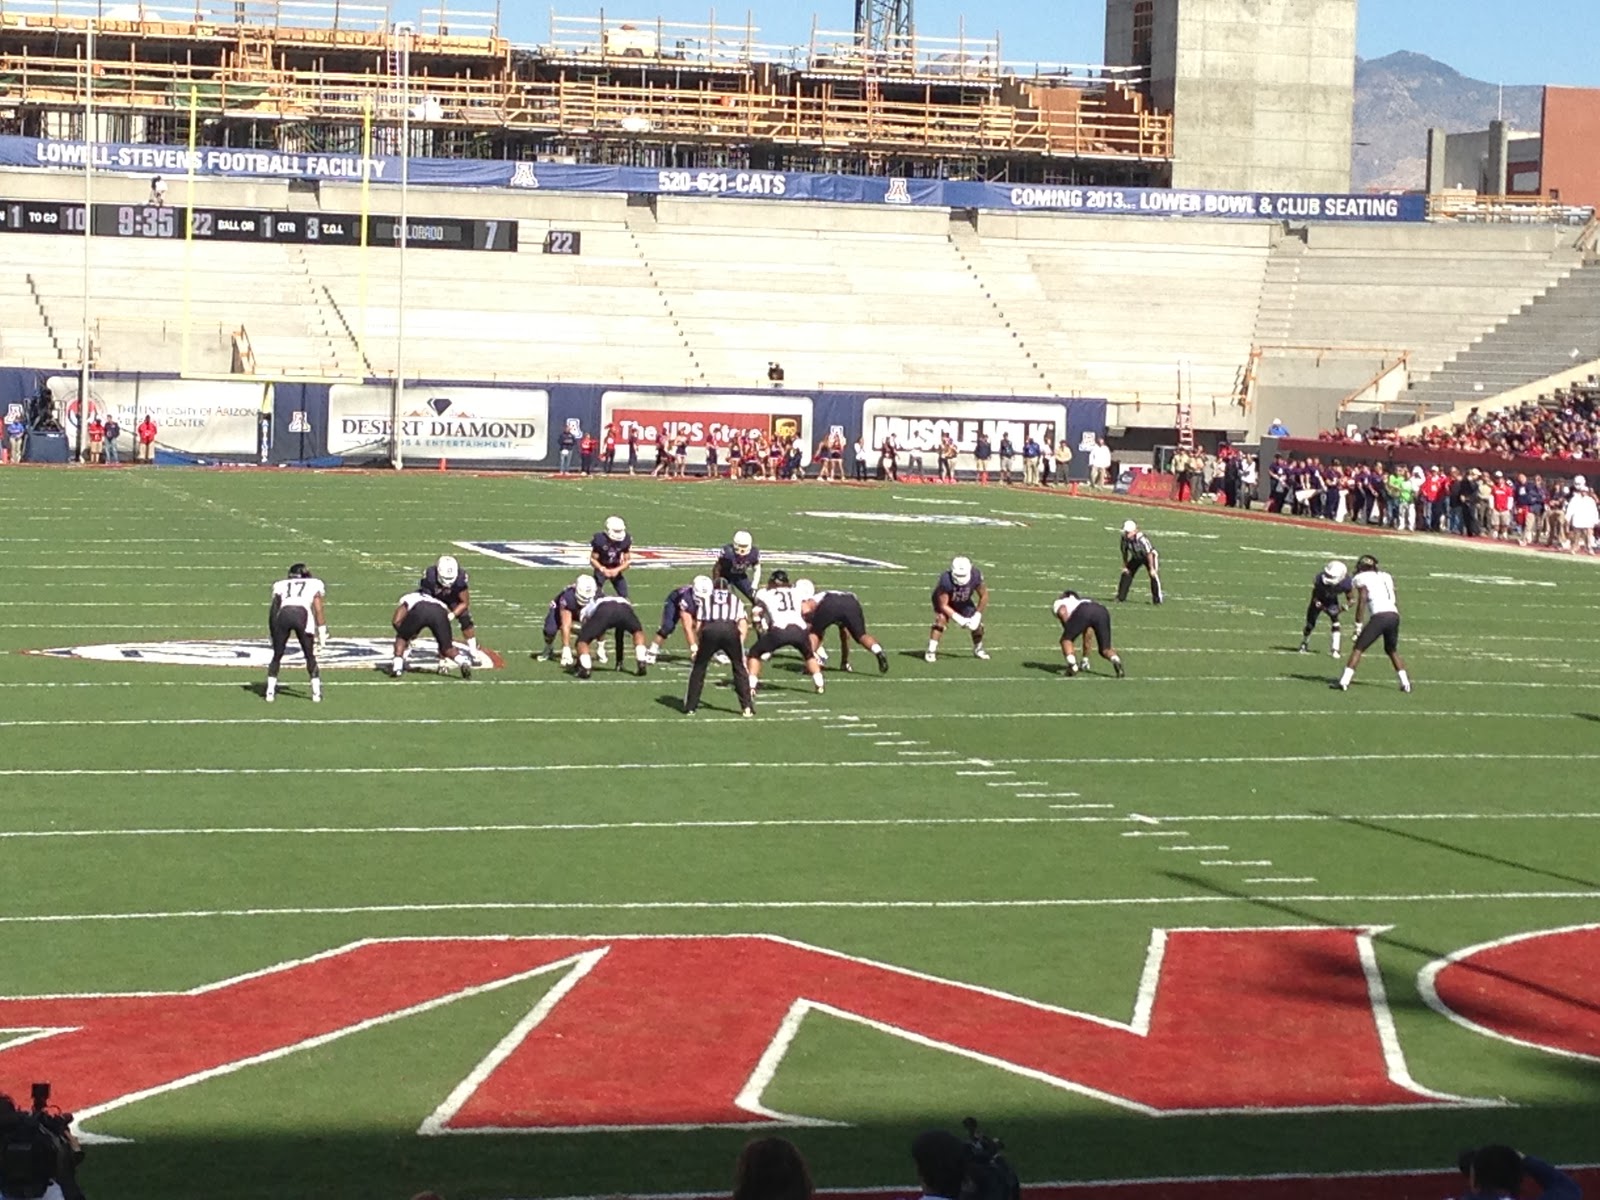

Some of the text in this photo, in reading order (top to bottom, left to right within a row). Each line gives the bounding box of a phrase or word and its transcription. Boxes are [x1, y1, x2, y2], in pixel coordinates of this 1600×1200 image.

[208, 152, 303, 174] FOOTBALL
[658, 172, 786, 195] 520-621-CATS
[1011, 188, 1082, 208] COMING
[1140, 192, 1200, 211] LOWER
[1204, 194, 1255, 213] BOWL
[1259, 197, 1273, 214] &
[1277, 198, 1320, 215] CLUB
[1325, 199, 1398, 216] SEATING
[12, 205, 20, 228] 1
[28, 212, 41, 222] TO
[43, 213, 57, 223] GO
[66, 207, 86, 230] 10
[118, 207, 174, 237] 9:35
[191, 213, 212, 236] 22
[217, 219, 240, 230] BALL
[263, 216, 272, 237] 1
[277, 222, 296, 233] QTR
[307, 217, 319, 239] 3
[485, 221, 498, 250] 7
[551, 232, 573, 253] 22
[431, 421, 535, 439] DIAMOND
[619, 420, 658, 441] The
[875, 417, 979, 452] MUSCLE
[285, 581, 307, 598] 17
[774, 591, 796, 612] 31
